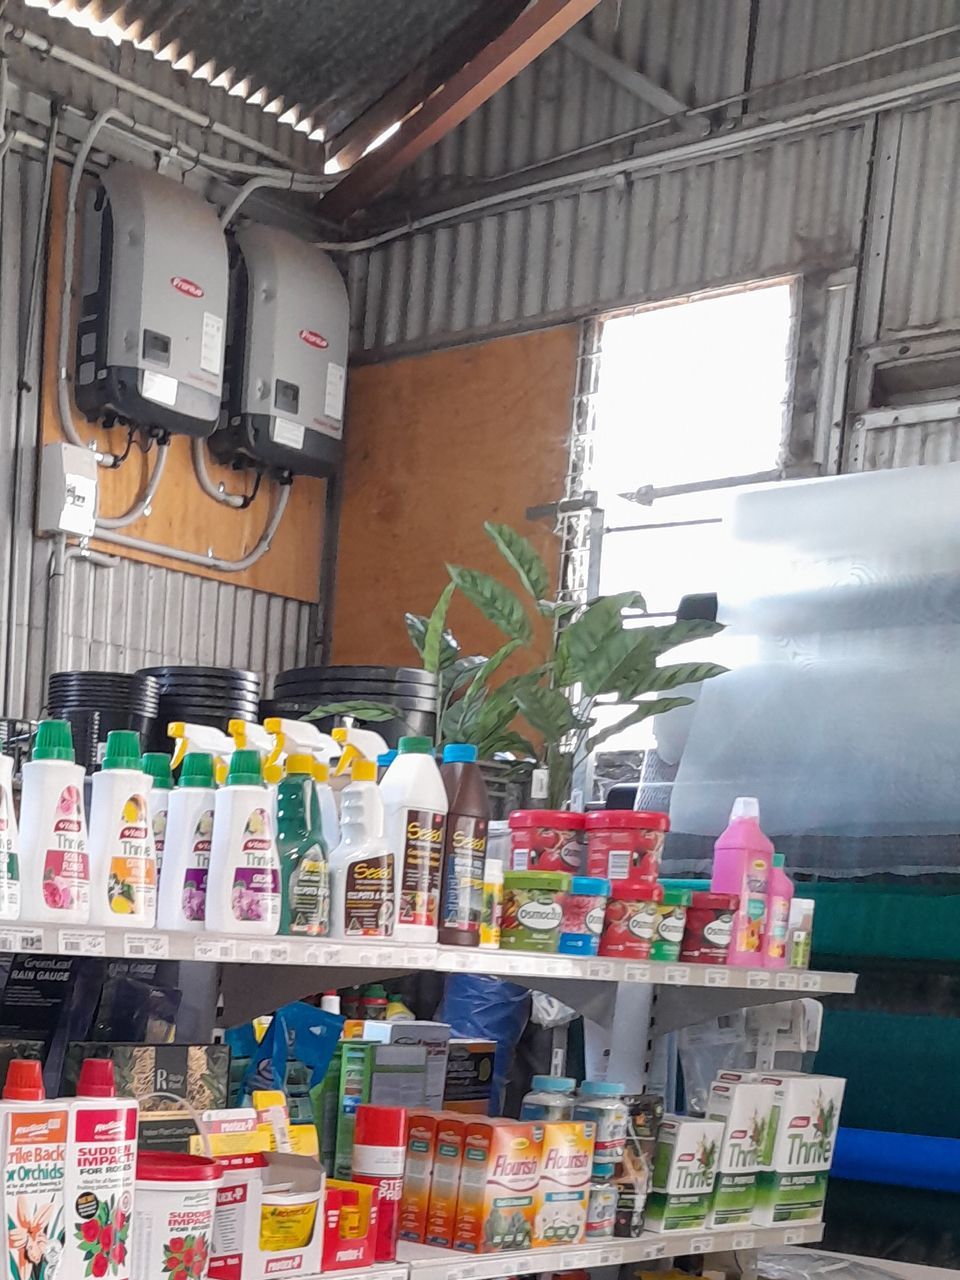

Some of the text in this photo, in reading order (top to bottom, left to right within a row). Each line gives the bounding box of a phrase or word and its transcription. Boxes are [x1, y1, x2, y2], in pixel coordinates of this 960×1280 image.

[34, 1148, 64, 1162] Back
[77, 1145, 131, 1157] SUDDEN
[730, 1143, 763, 1168] Thrive
[787, 1133, 831, 1165] Thrive
[77, 1155, 134, 1168] IMPACT!
[493, 1155, 537, 1177] Flourish
[544, 1149, 588, 1170] Flourish
[17, 1164, 64, 1181] Orchids
[80, 1167, 102, 1175] FOR
[676, 1166, 714, 1189] Thrive
